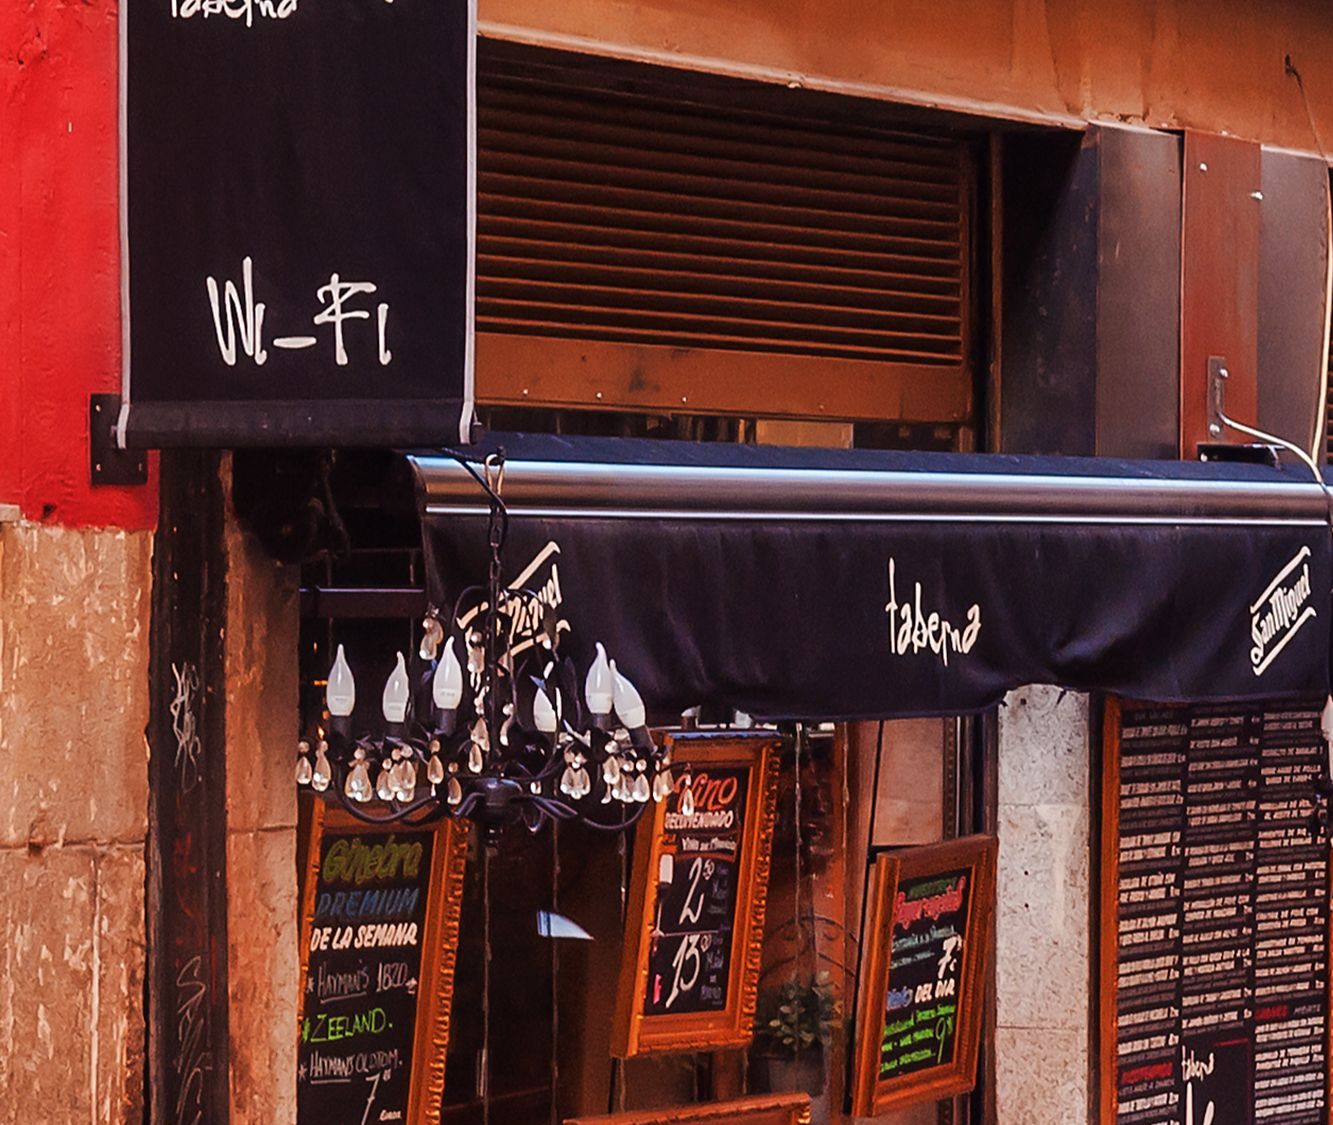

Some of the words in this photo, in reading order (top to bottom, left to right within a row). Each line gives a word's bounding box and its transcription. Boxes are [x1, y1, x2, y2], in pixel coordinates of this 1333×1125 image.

[885, 557, 982, 667] taberna
[316, 888, 420, 918] PREMIUM
[309, 926, 334, 953] DE
[331, 925, 354, 951] LA
[353, 921, 419, 949] SEMANA
